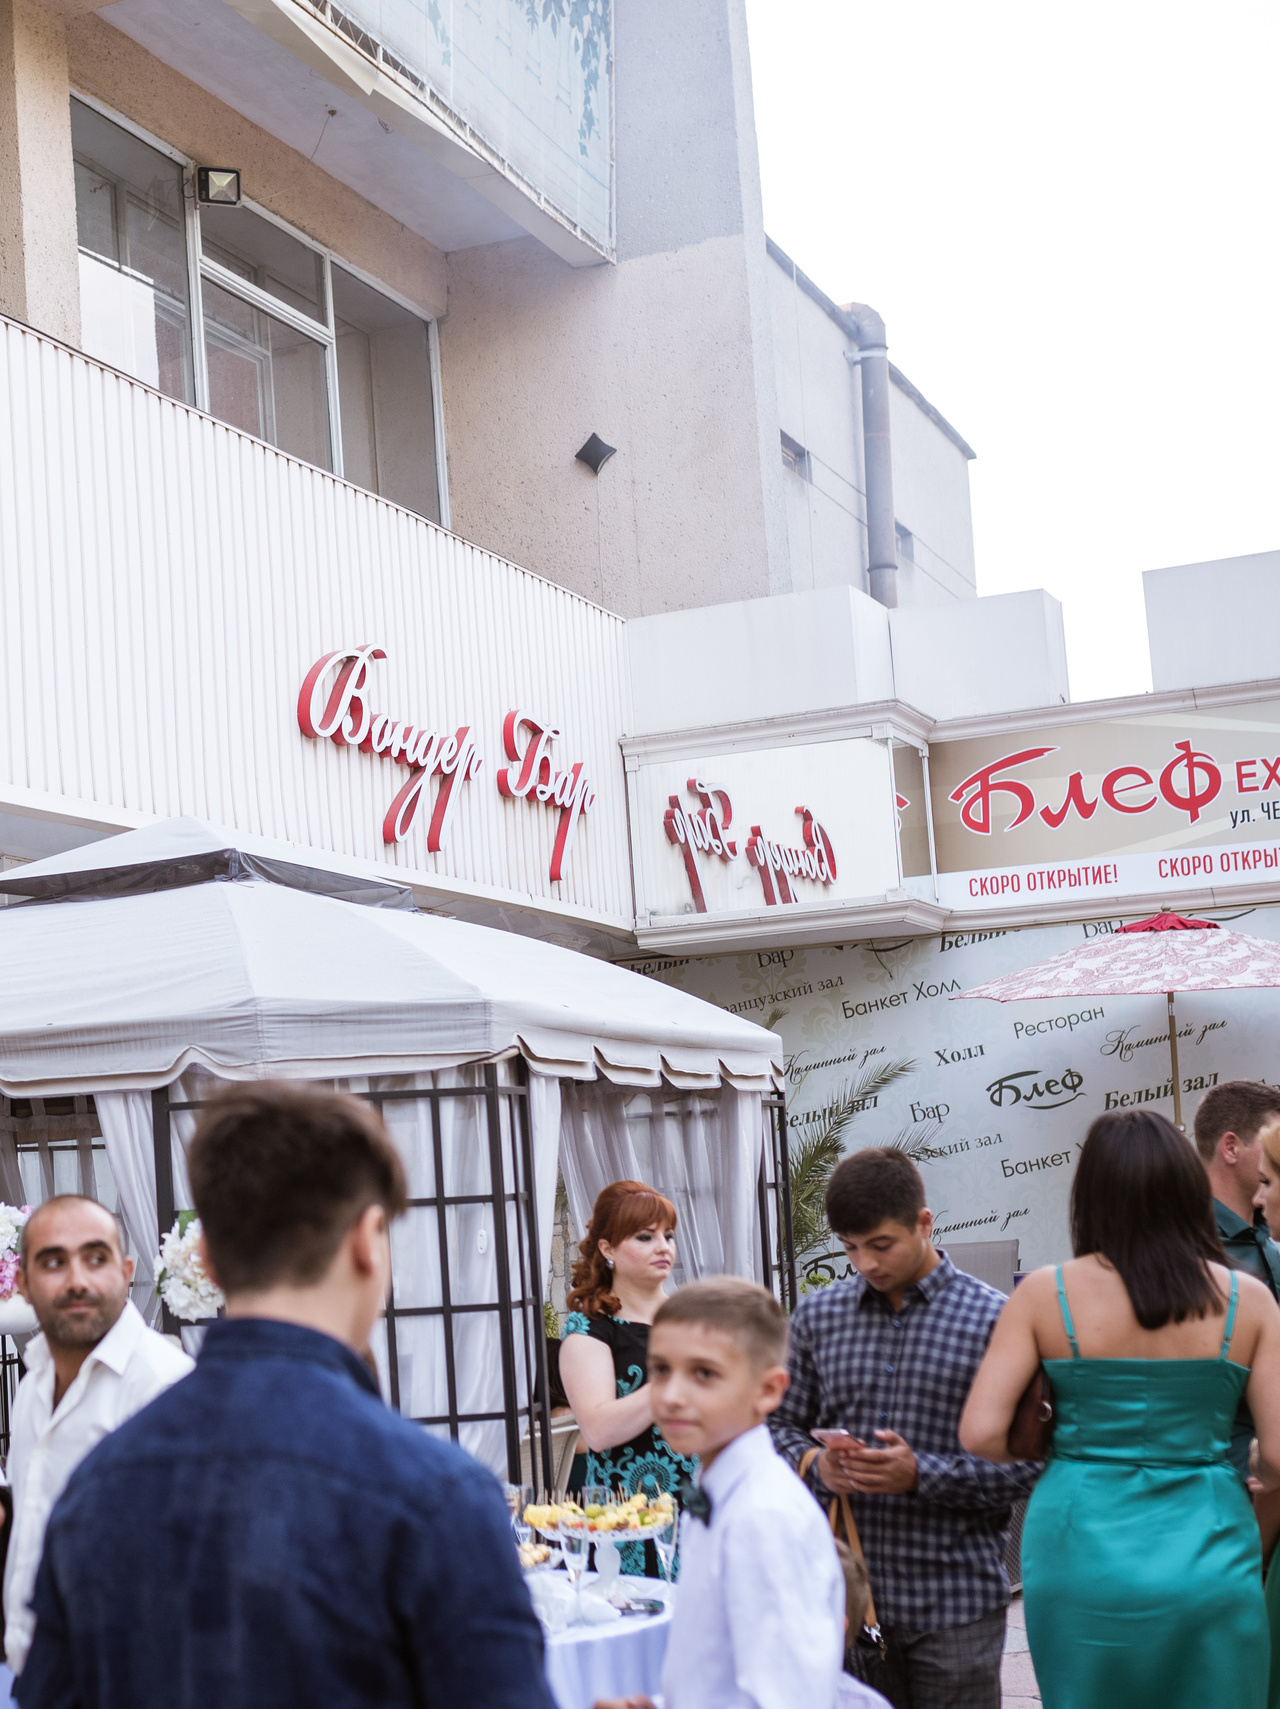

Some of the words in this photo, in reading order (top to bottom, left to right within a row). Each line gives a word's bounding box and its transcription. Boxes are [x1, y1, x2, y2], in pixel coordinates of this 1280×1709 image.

[497, 709, 596, 881] Бар
[1230, 809, 1256, 829] ул.
[1158, 854, 1213, 878] СКОРО
[1220, 847, 1280, 872] ОТКРЫ
[969, 873, 1020, 897] СКОРО
[1027, 863, 1118, 891] ОТКРЫТИЕ!
[817, 976, 844, 991] зал
[842, 991, 909, 1019] Банкет
[912, 979, 961, 999] Холл
[1013, 1006, 1105, 1039] Ресторан
[934, 1044, 986, 1067] Холл
[1103, 1077, 1175, 1111] Белый
[1182, 1072, 1220, 1093] зал
[908, 1101, 950, 1124] Бар
[974, 1133, 1003, 1149] зал
[1001, 1151, 1072, 1178] Банкет
